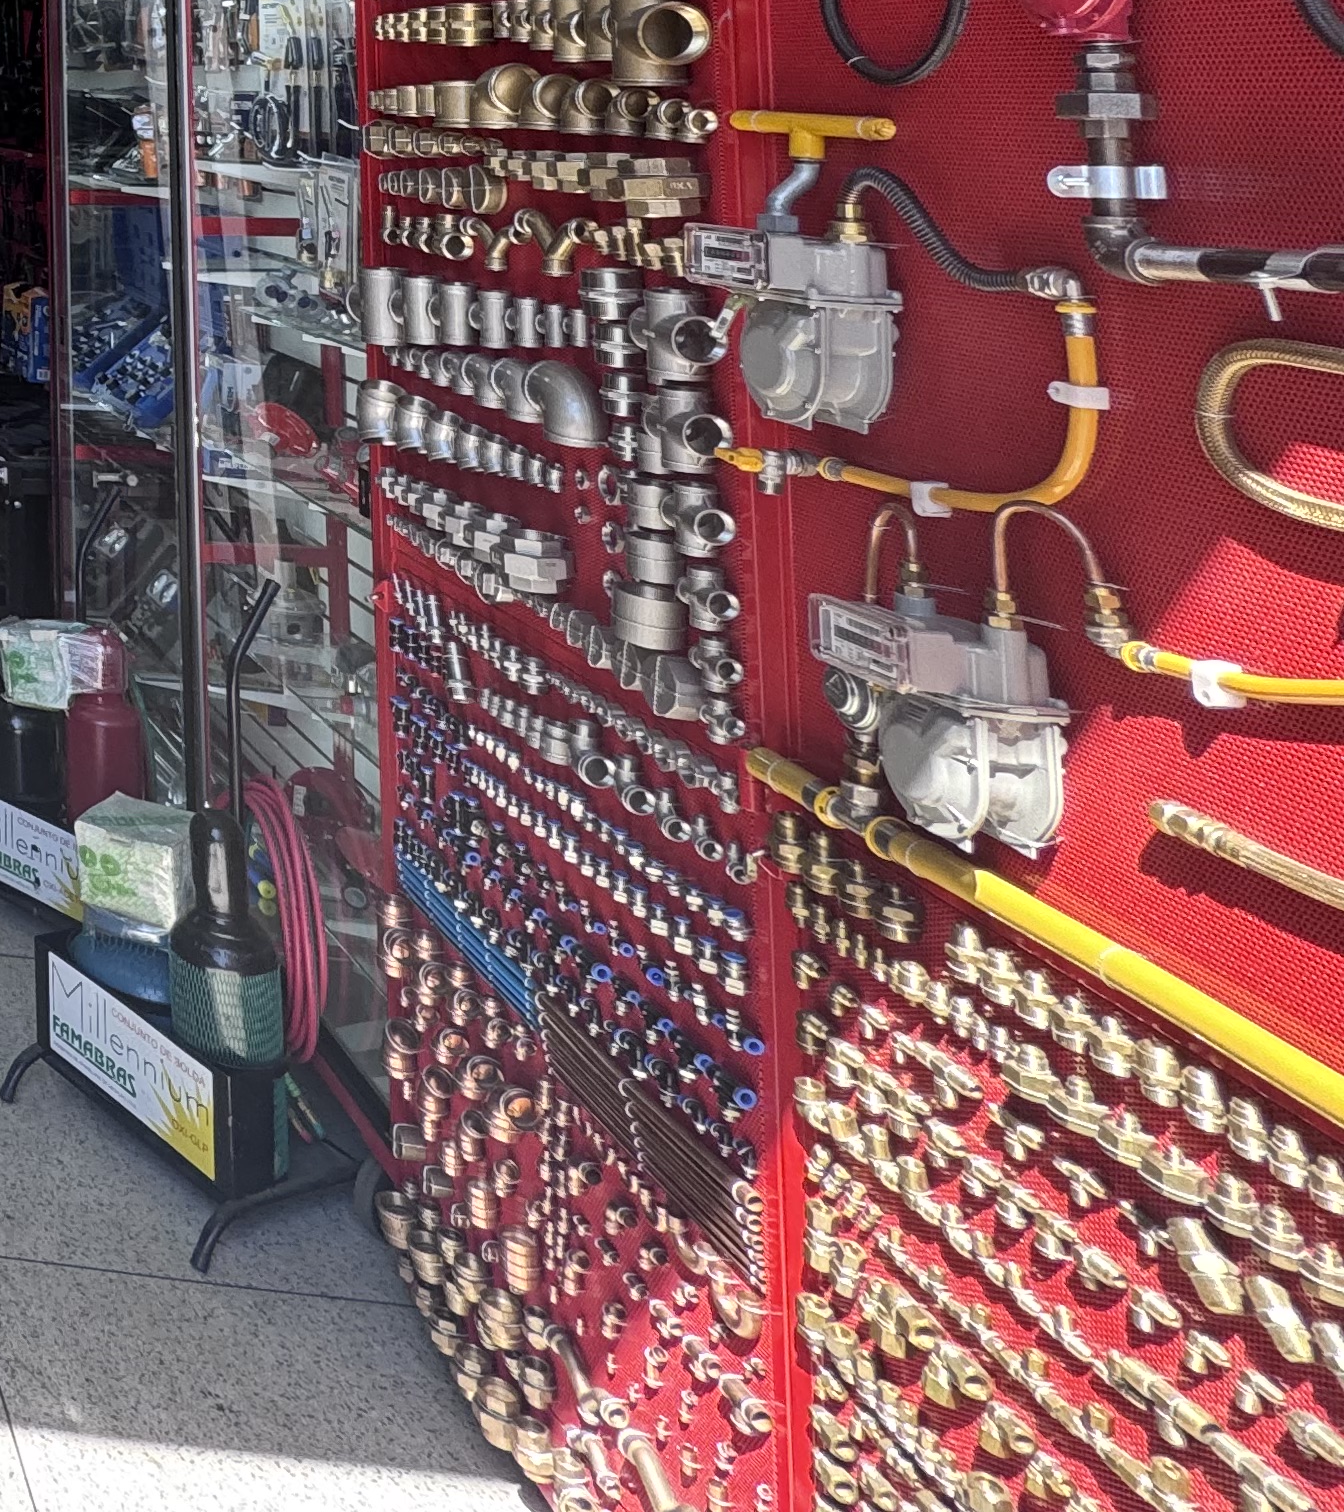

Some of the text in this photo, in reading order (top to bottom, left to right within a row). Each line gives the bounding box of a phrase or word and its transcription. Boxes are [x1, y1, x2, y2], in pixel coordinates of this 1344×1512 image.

[52, 961, 209, 1127] Millennium
[53, 1014, 137, 1099] FAMABRAS
[112, 1008, 158, 1049] CONJUNTO
[160, 1044, 172, 1062] DE
